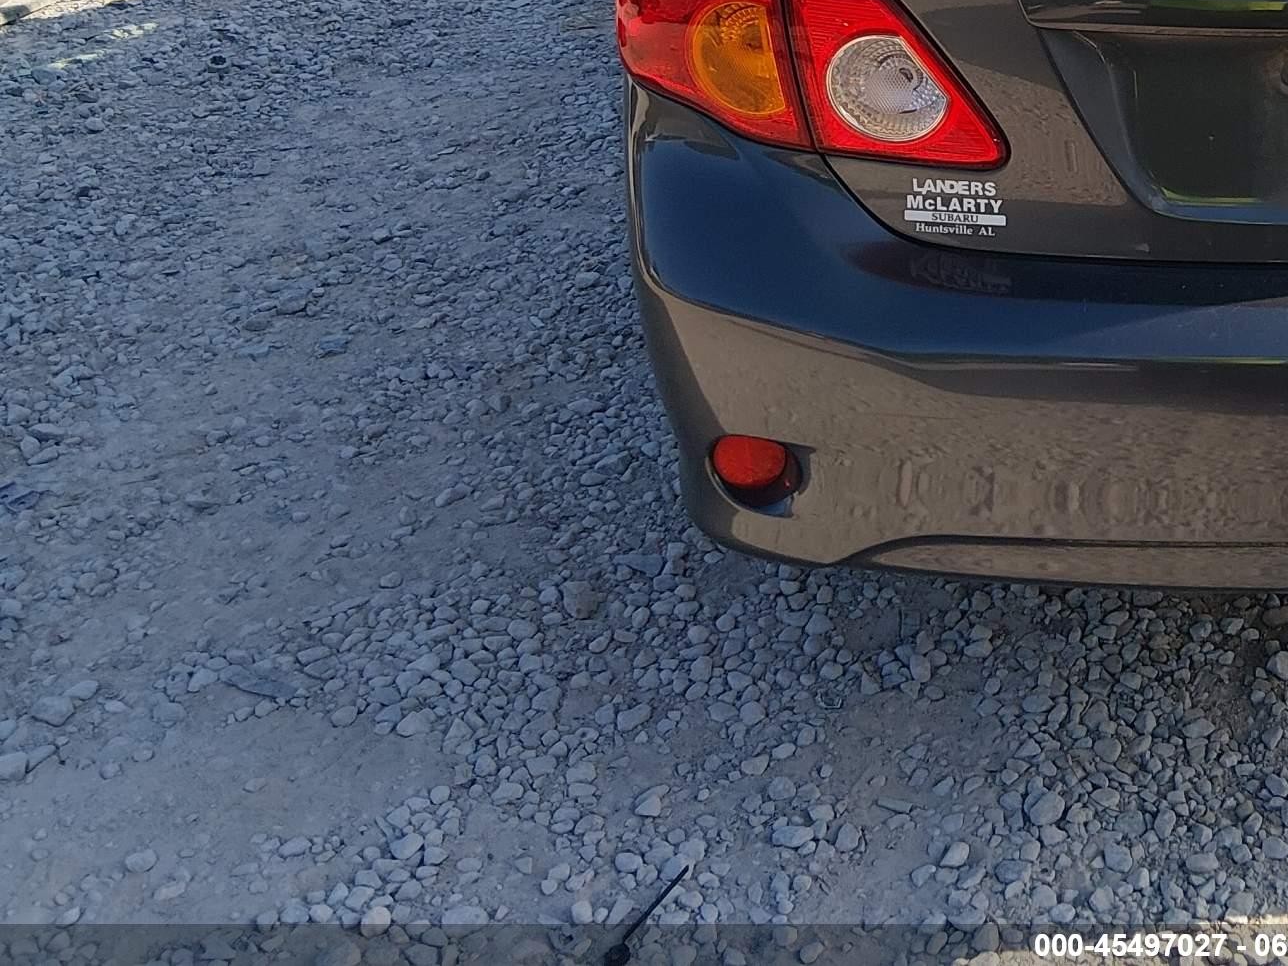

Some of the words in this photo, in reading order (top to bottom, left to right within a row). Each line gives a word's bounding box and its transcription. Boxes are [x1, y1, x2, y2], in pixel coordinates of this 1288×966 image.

[912, 178, 997, 196] LANDERS
[906, 195, 1003, 213] McLARTY
[931, 213, 979, 223] SUBARU
[915, 222, 974, 235] Huntsville
[978, 226, 996, 236] AL
